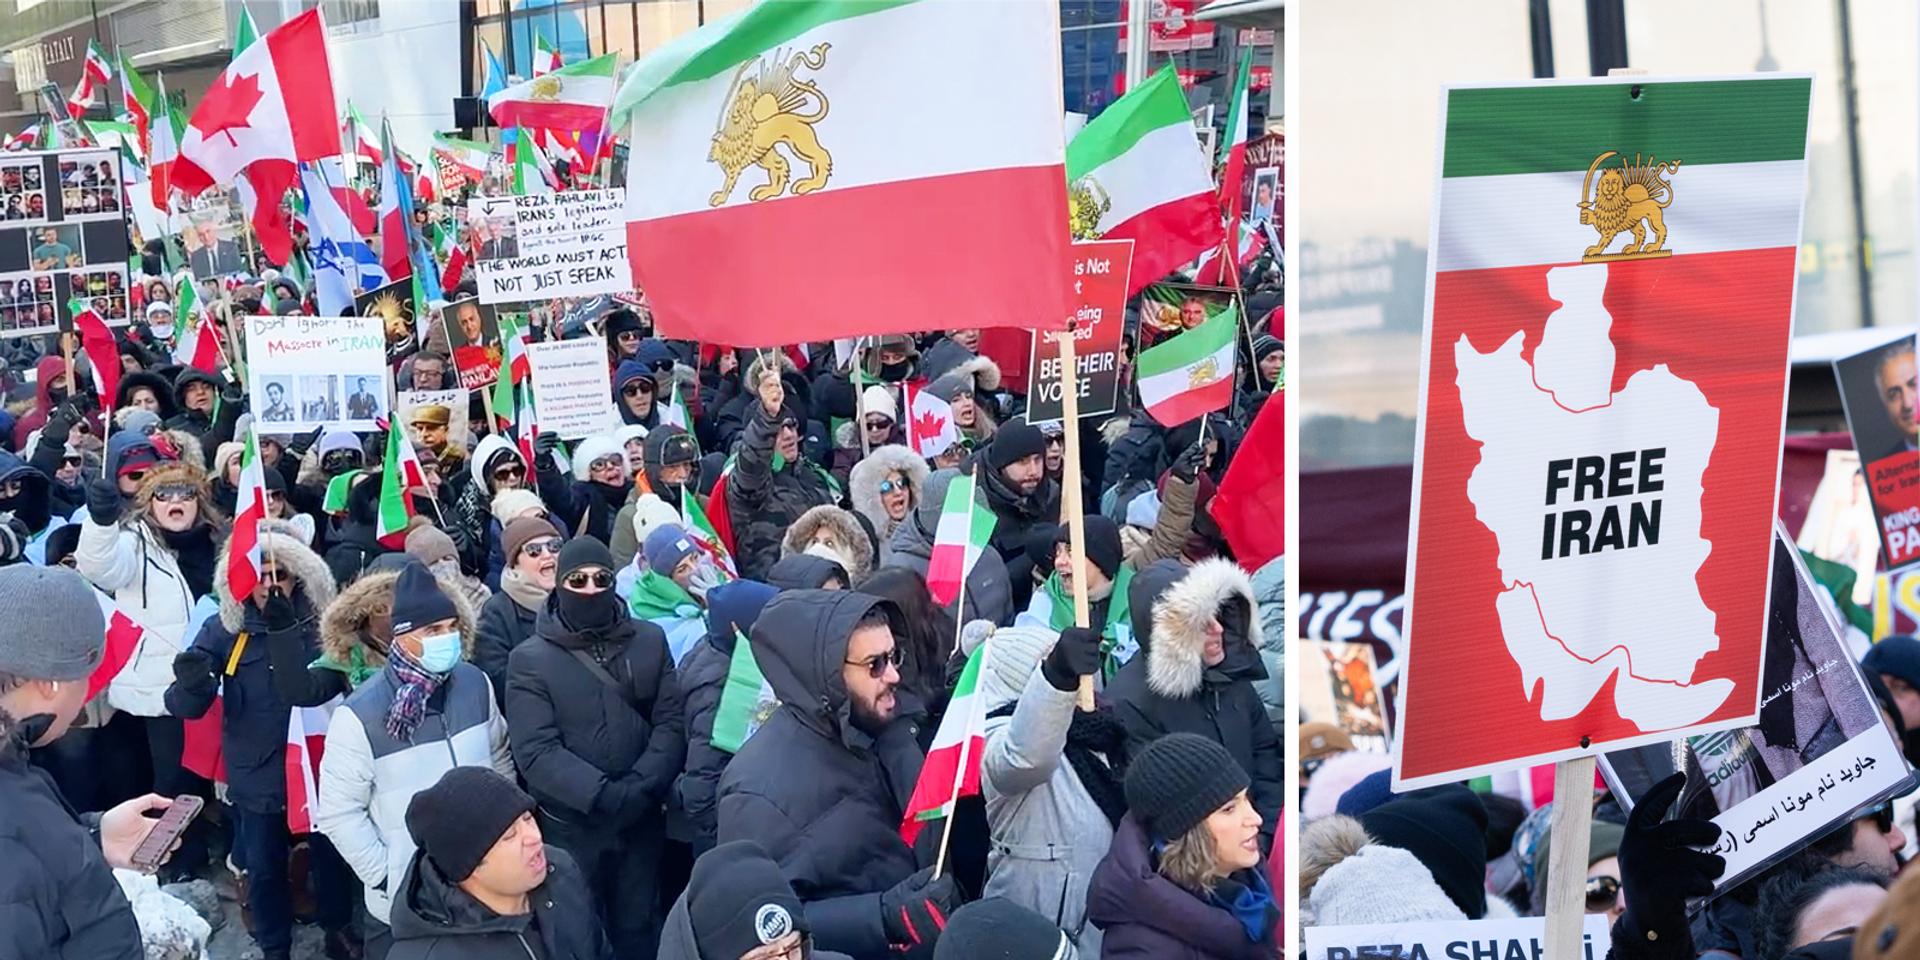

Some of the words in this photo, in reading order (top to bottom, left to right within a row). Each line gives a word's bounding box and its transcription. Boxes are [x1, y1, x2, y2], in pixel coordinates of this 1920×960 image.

[514, 194, 549, 207] REZA
[554, 191, 601, 205] PAHLAVI
[564, 201, 624, 221] legitimate
[520, 223, 542, 237] and
[547, 222, 567, 235] sole
[477, 260, 505, 274] THE
[509, 254, 550, 270] WORLD
[555, 249, 595, 264] MUST
[600, 245, 627, 260] ACT
[1087, 258, 1111, 275] Not
[493, 275, 524, 294] NOT
[532, 270, 563, 292] JUST
[567, 265, 616, 285] SPEAK
[1077, 305, 1103, 325] eing
[267, 339, 323, 358] Massacre
[326, 336, 340, 346] in
[340, 334, 383, 353] IRAN
[1040, 358, 1062, 380] BE
[1037, 377, 1091, 404] VOE
[1545, 447, 1666, 506] FREE
[1877, 481, 1895, 496] for
[1541, 499, 1662, 560] IRAN
[1882, 505, 1920, 533] KING
[1800, 669, 1814, 685] نام
[1815, 657, 1838, 676] جاوید
[1840, 756, 1876, 783] جاوید
[1817, 772, 1836, 801] نام
[1781, 792, 1813, 813] مونا
[1743, 806, 1780, 844] اسمی
